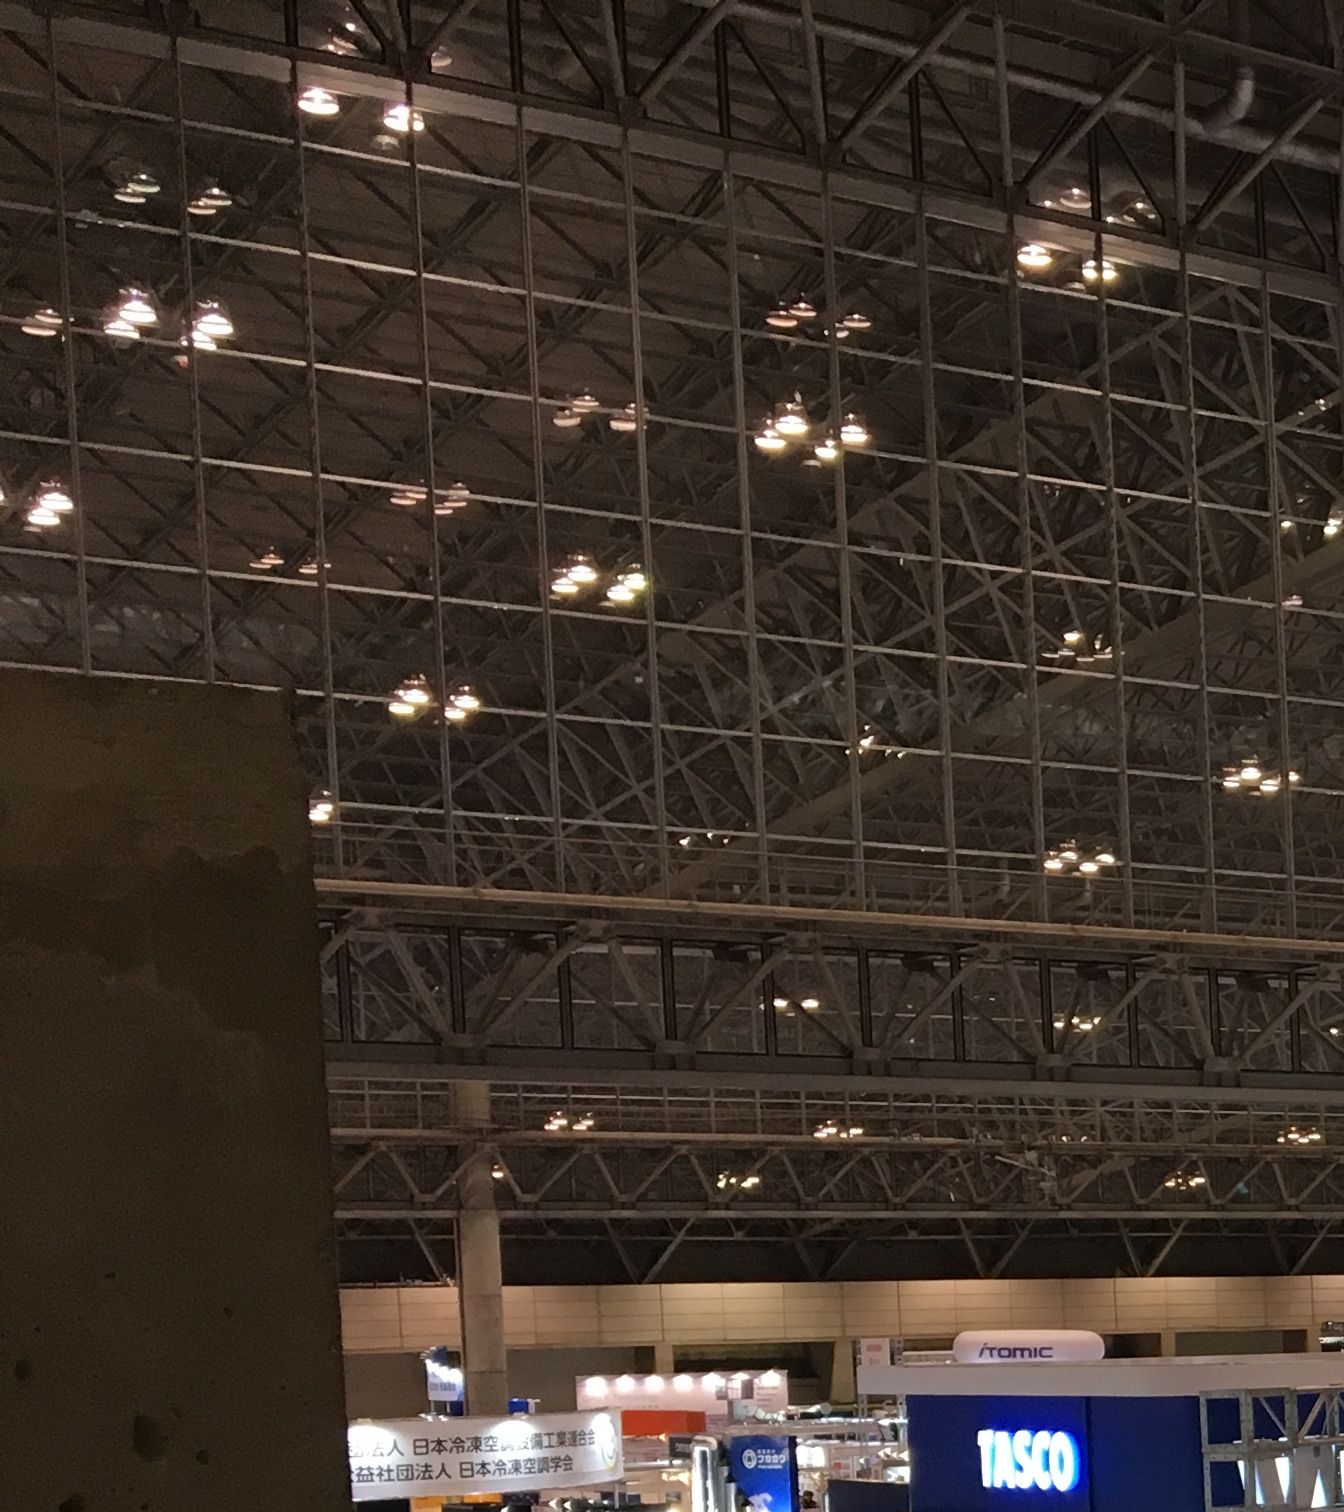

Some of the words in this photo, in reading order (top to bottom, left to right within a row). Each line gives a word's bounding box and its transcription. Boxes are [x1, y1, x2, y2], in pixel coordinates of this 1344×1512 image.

[459, 1455, 574, 1478] 日本冷凍空調学会
[977, 1430, 1081, 1491] TASCO
